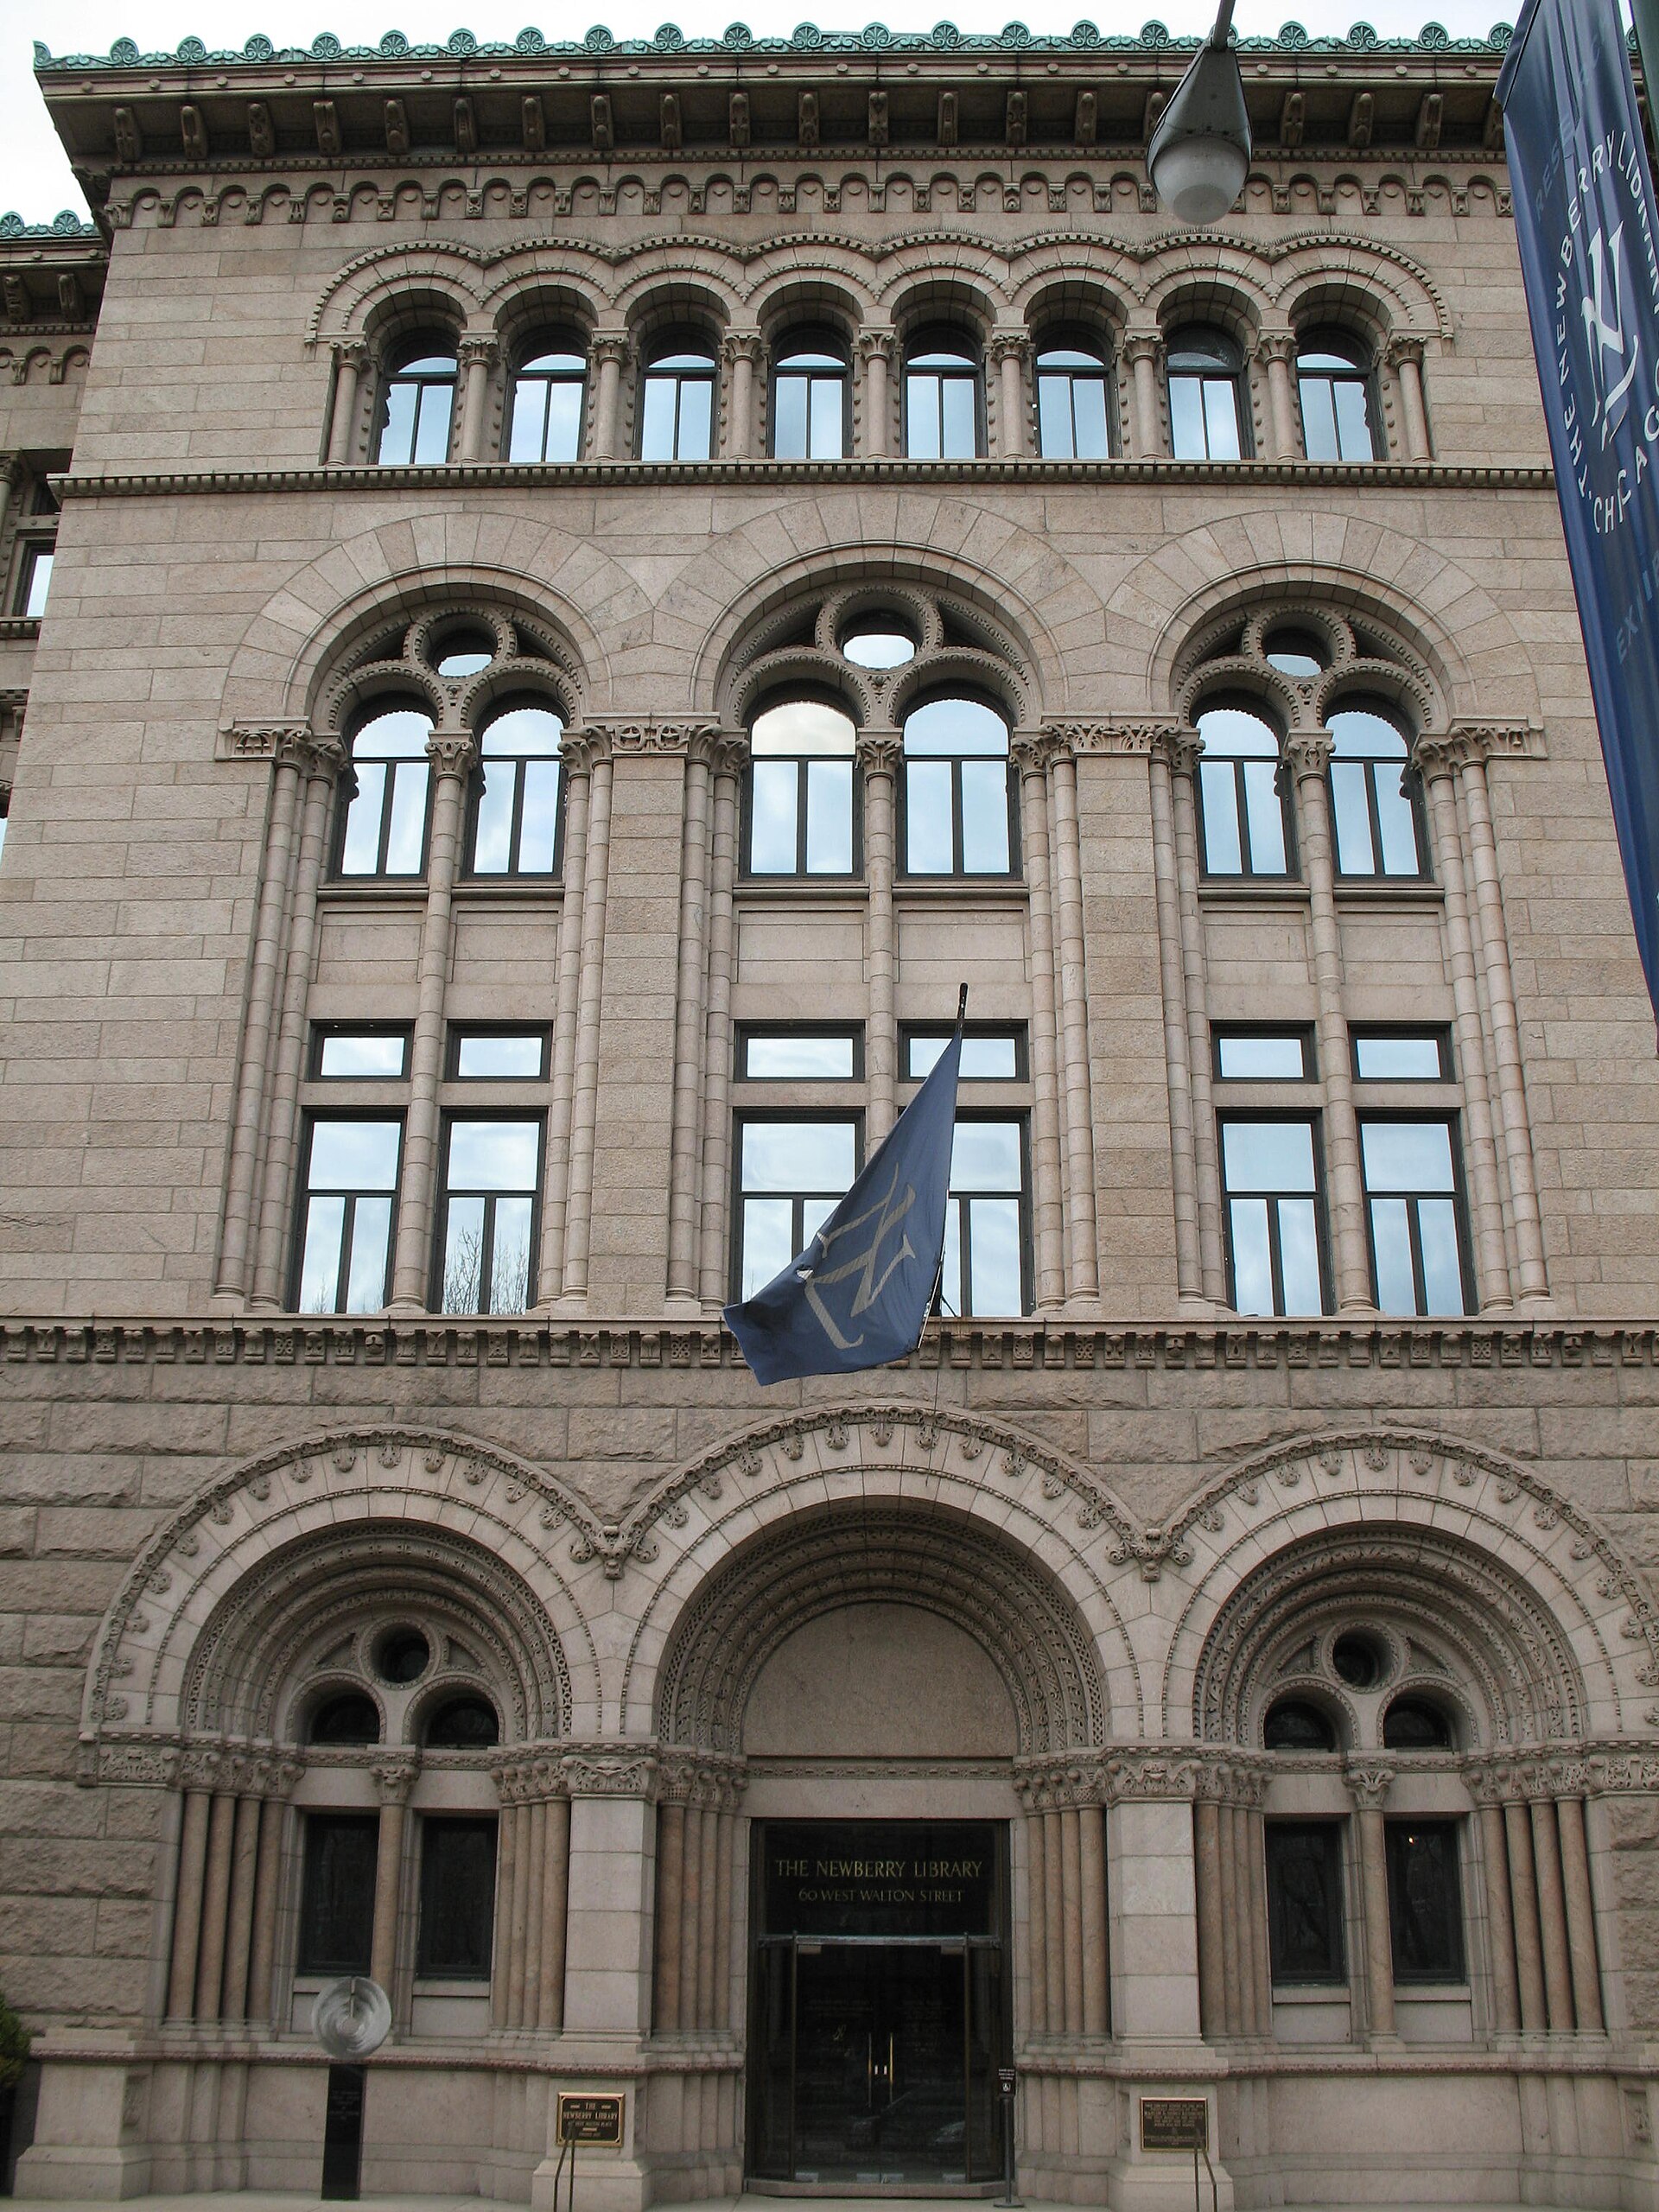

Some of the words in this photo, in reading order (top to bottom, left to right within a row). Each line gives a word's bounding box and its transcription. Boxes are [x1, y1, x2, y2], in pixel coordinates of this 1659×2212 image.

[1555, 129, 1615, 387] NEWBERRY
[1563, 392, 1588, 499] THE
[775, 1859, 810, 1878] THE
[817, 1859, 906, 1878] NEWBERRY
[913, 1860, 983, 1878] LIBRARY
[798, 1887, 818, 1903] 60
[820, 1889, 857, 1903] WEST
[860, 1889, 915, 1903] WALTON
[920, 1889, 964, 1903] STREET
